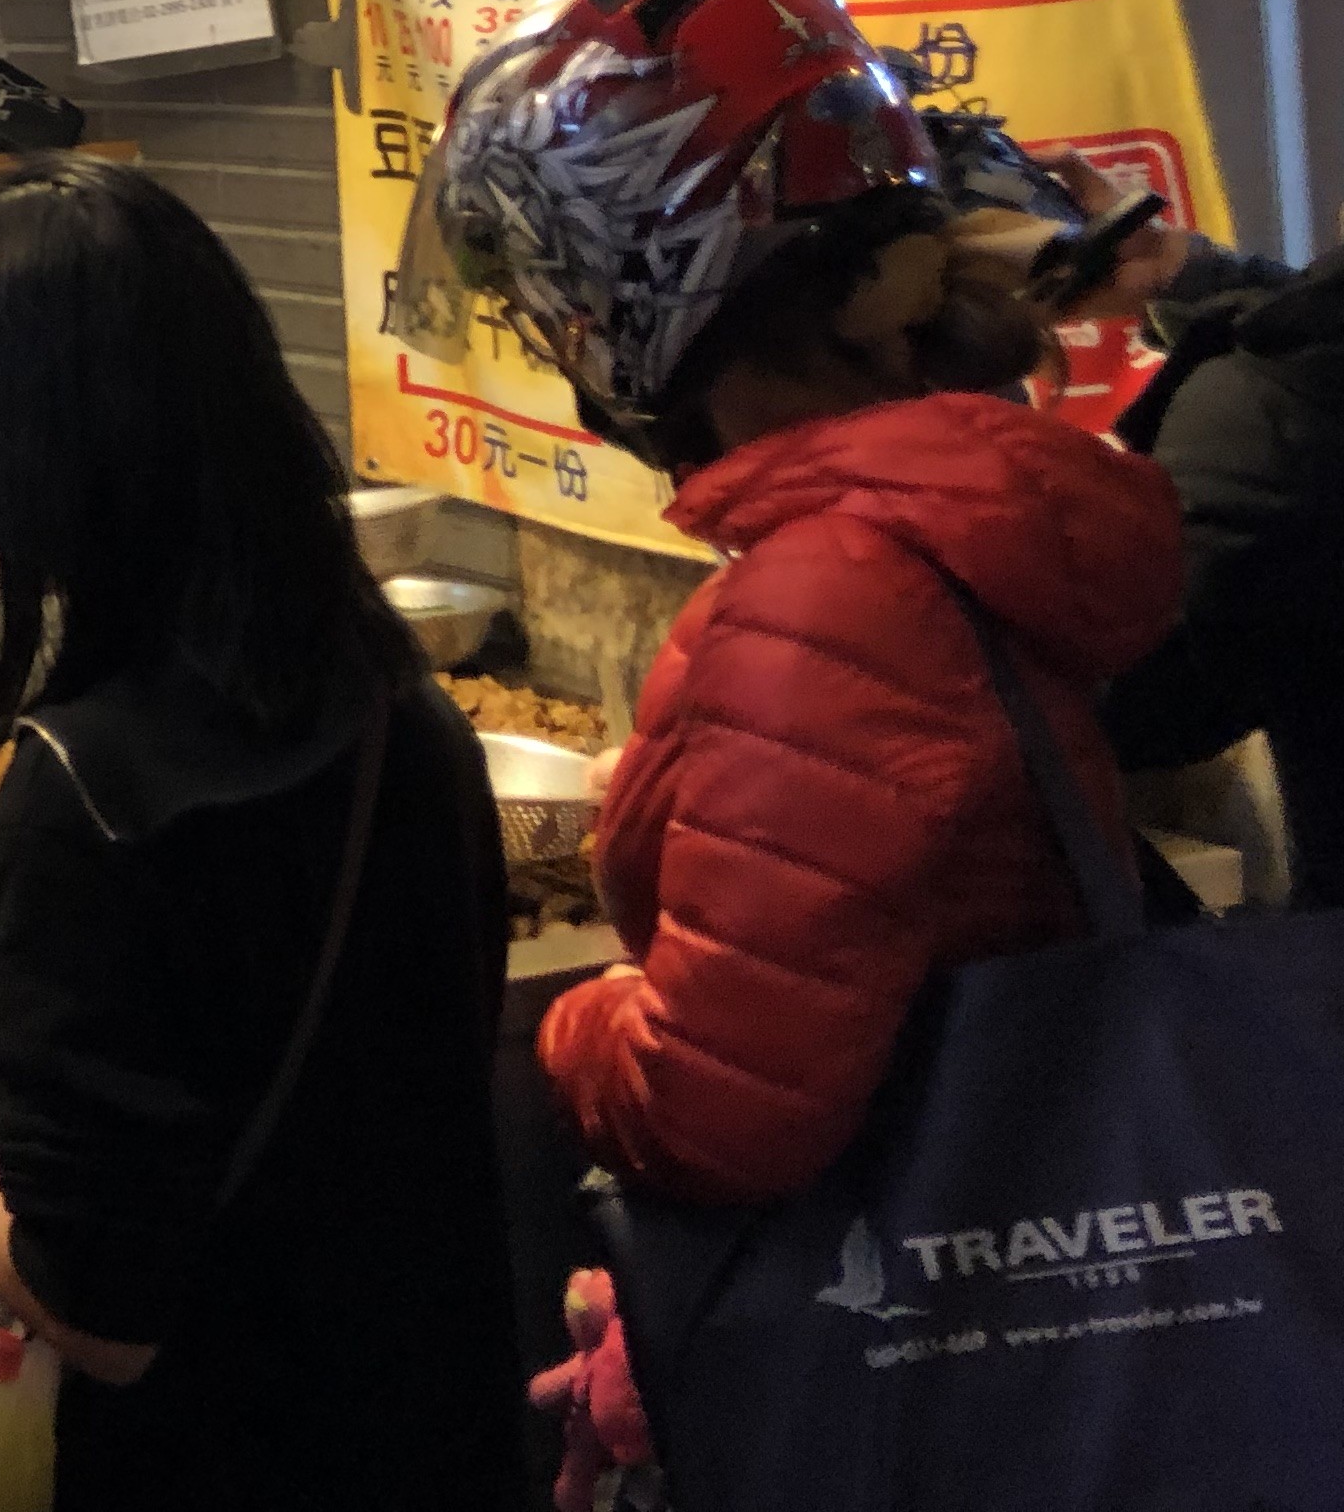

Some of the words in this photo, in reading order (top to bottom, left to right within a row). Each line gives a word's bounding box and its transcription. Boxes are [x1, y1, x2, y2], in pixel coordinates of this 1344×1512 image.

[423, 408, 590, 503] 30元一份
[903, 1187, 1284, 1283] TRAVELER
